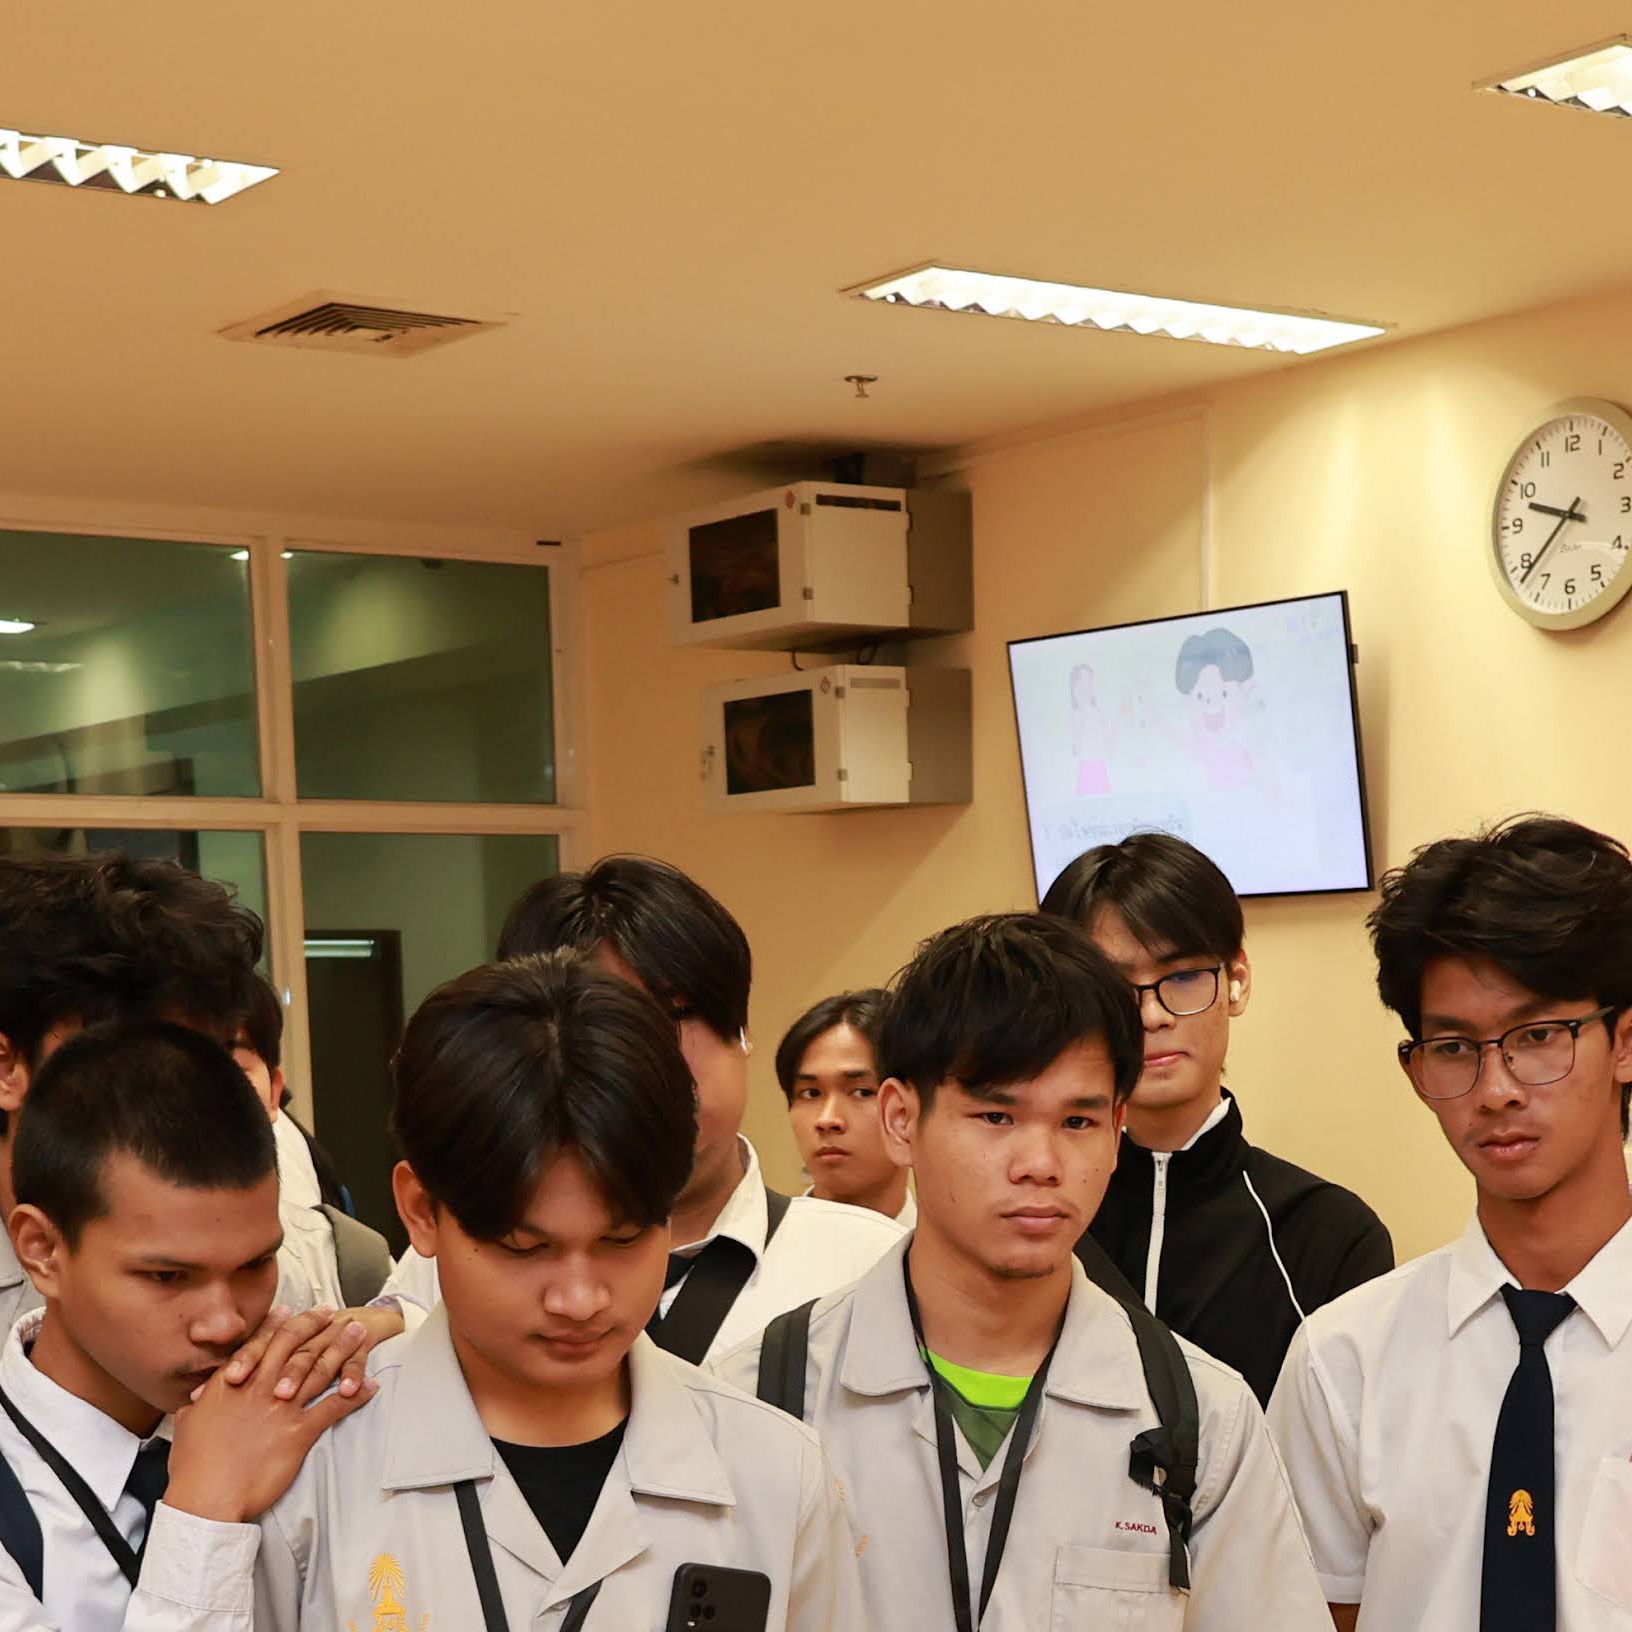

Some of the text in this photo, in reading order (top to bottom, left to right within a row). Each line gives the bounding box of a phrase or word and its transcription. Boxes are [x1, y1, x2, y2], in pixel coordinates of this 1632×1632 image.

[1565, 435, 1581, 453] 12
[1597, 439, 1603, 455] 1
[1540, 451, 1550, 468] 11
[1613, 463, 1625, 480] 2
[1519, 482, 1537, 499] 10
[1620, 497, 1632, 513] 3
[1512, 517, 1524, 534] 9
[1611, 535, 1623, 550] 4
[1520, 553, 1532, 569] 8
[1590, 564, 1602, 581] 5
[1540, 573, 1552, 590] 7
[1564, 578, 1576, 595] 6
